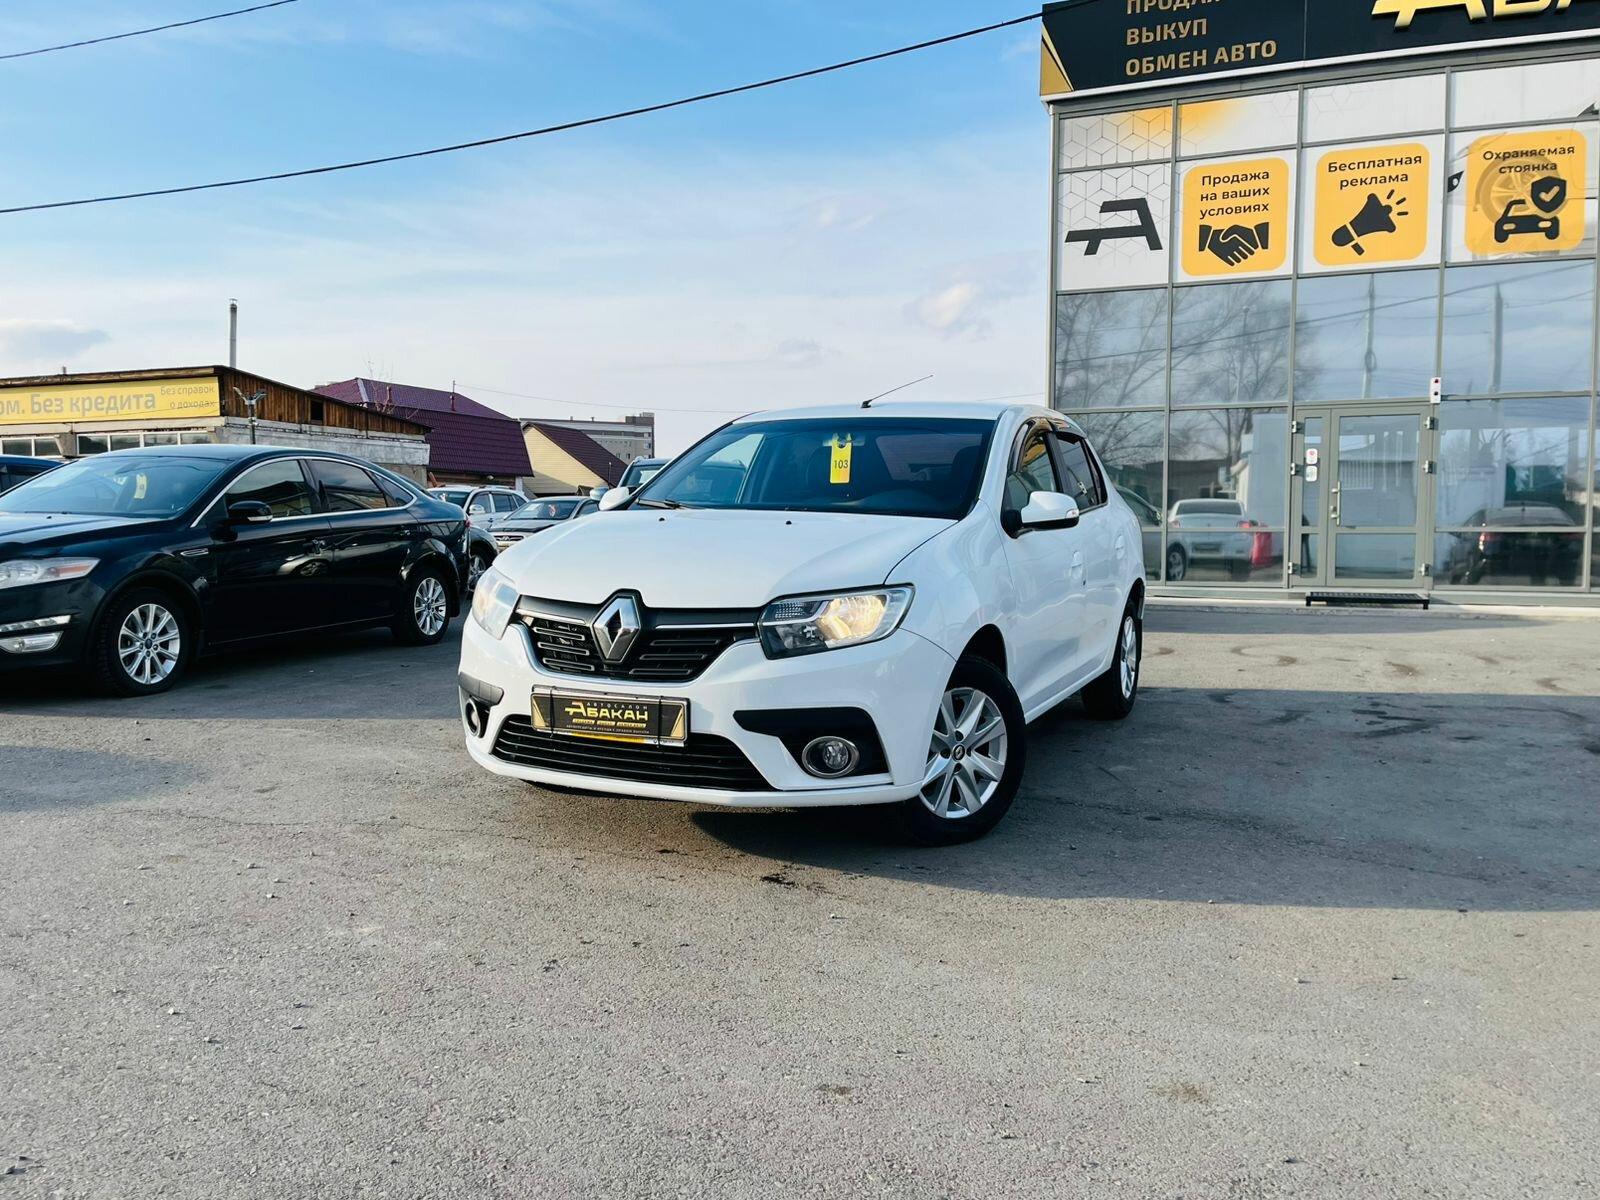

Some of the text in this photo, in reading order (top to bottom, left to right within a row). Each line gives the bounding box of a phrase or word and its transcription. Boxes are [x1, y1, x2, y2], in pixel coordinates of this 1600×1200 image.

[1126, 18, 1208, 46] ВЫКУП
[1125, 40, 1277, 76] ОБМЕН АВТО
[1483, 146, 1576, 161] Охраняемая
[1328, 155, 1422, 173] Бесплатная
[1499, 162, 1558, 174] стоянка
[1202, 171, 1270, 187] Продажа
[1340, 173, 1409, 190] реклама
[1200, 187, 1270, 202] на ваших
[1200, 203, 1270, 220] условиях
[160, 385, 215, 396] Без справок
[31, 394, 63, 414] Без
[70, 392, 156, 416] кредита
[833, 460, 849, 469] 103
[565, 701, 648, 721] АБАКАН
